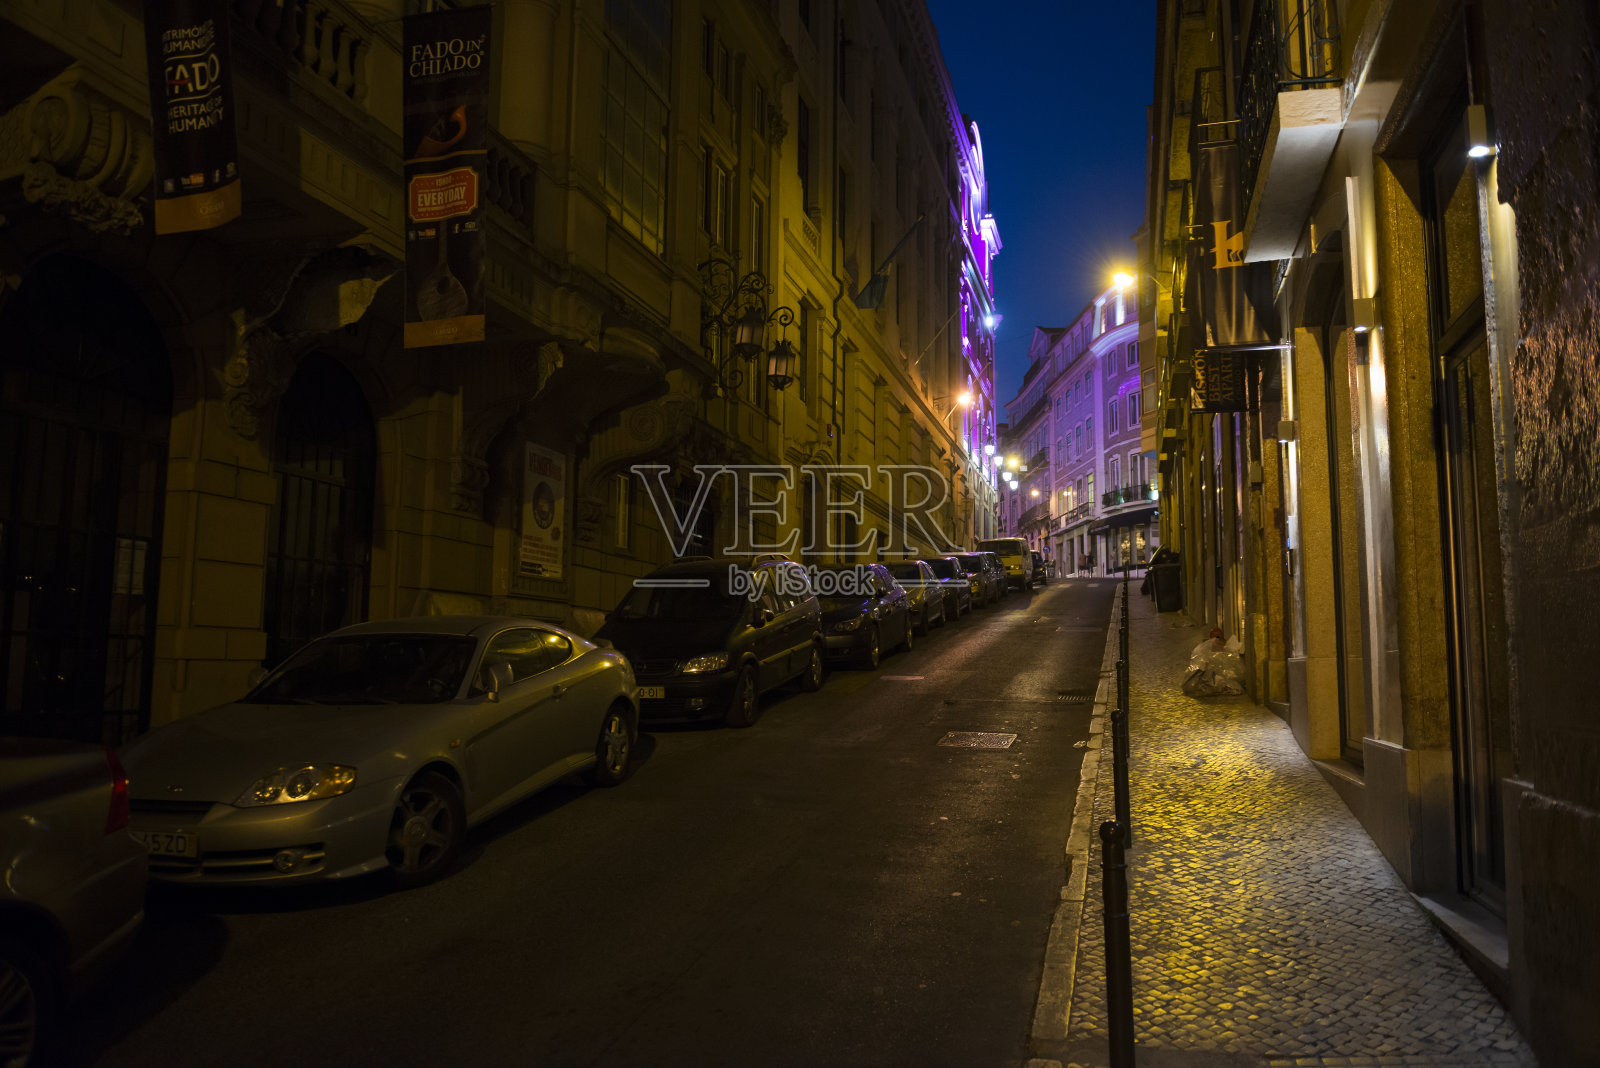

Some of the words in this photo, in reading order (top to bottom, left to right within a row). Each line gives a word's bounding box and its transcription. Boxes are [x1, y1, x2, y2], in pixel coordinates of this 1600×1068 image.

[412, 38, 464, 62] FADO
[466, 39, 482, 52] IN
[165, 53, 220, 96] FADO
[409, 53, 481, 78] CHIADO
[417, 186, 467, 207] EVERYDAY
